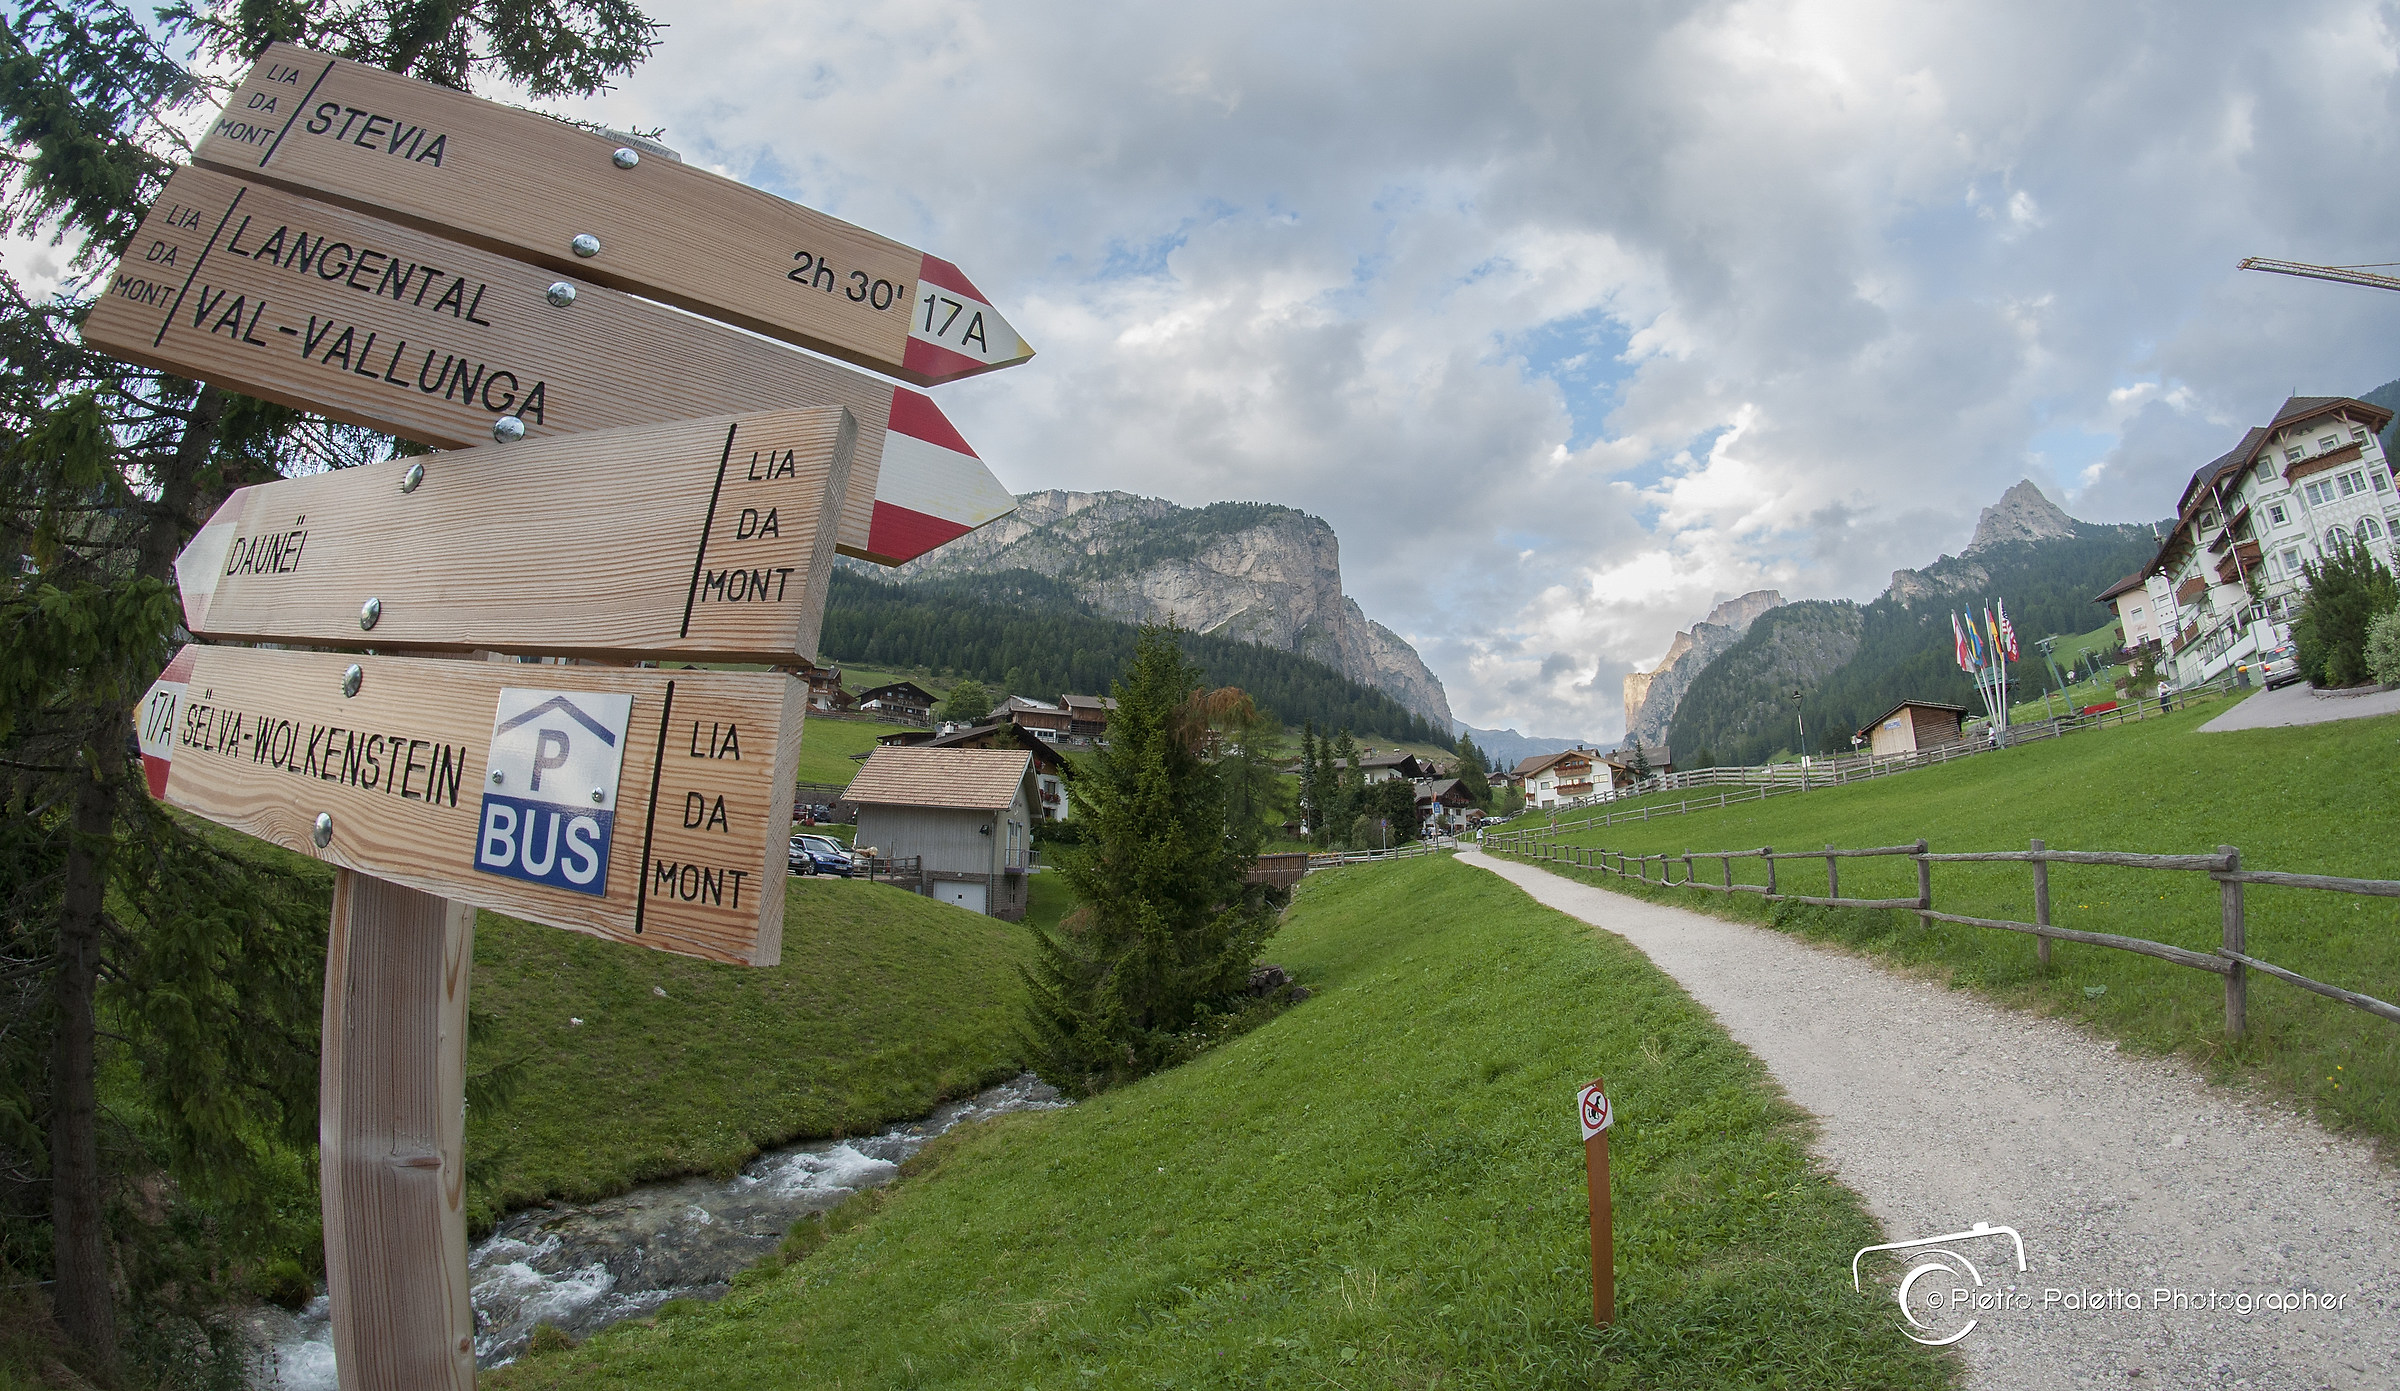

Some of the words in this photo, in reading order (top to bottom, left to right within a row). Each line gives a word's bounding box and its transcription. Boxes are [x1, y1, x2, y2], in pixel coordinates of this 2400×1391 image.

[266, 63, 300, 86] LIA
[246, 92, 278, 114] DA
[213, 118, 275, 147] MONT
[307, 102, 447, 167] STEVIA
[166, 204, 200, 231] LIA
[145, 240, 177, 267] DA
[227, 215, 491, 327] LANGENTAL
[111, 274, 176, 309] MONT
[787, 251, 835, 293] 2h
[845, 270, 904, 311] 30'
[923, 293, 988, 354] 17A
[193, 285, 546, 426] VAL-VALLUNGA
[747, 448, 796, 481] LIA
[736, 507, 780, 540] DA
[702, 567, 794, 603] MONT
[145, 691, 177, 747] 17A
[182, 688, 467, 808] SËLVA-WOLKENSTEIN
[530, 728, 570, 792] P
[690, 721, 740, 761] LIA
[683, 791, 729, 833] DA
[481, 803, 600, 885] BUS
[653, 860, 748, 910] MONT
